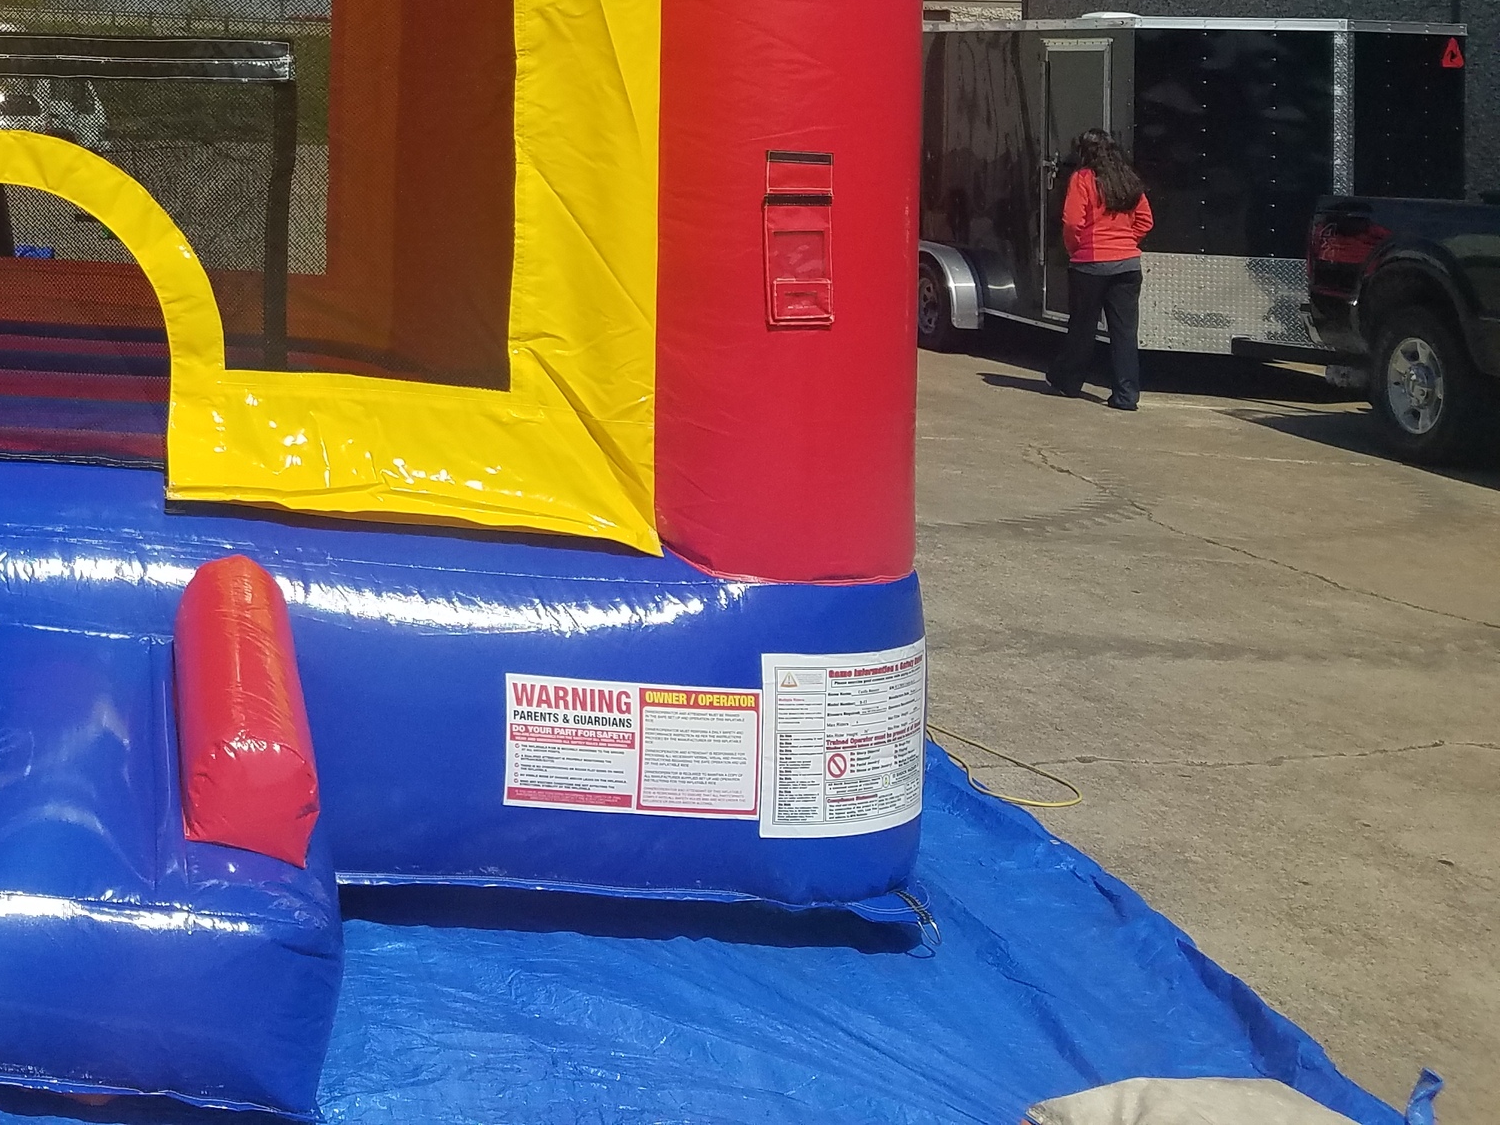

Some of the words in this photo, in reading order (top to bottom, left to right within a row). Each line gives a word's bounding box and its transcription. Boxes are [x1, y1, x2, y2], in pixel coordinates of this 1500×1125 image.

[512, 682, 632, 715] WARNING
[645, 691, 687, 705] OWNER
[690, 693, 696, 705] /
[698, 694, 756, 707] OPERATOR
[513, 710, 559, 723] PARENTS
[562, 713, 570, 724] &
[573, 714, 632, 728] GUARDIANS
[527, 725, 552, 734] YOUR
[554, 727, 577, 736] PART
[578, 729, 596, 738] FOR
[596, 731, 632, 739] SAFETY!
[850, 736, 873, 744] Operator
